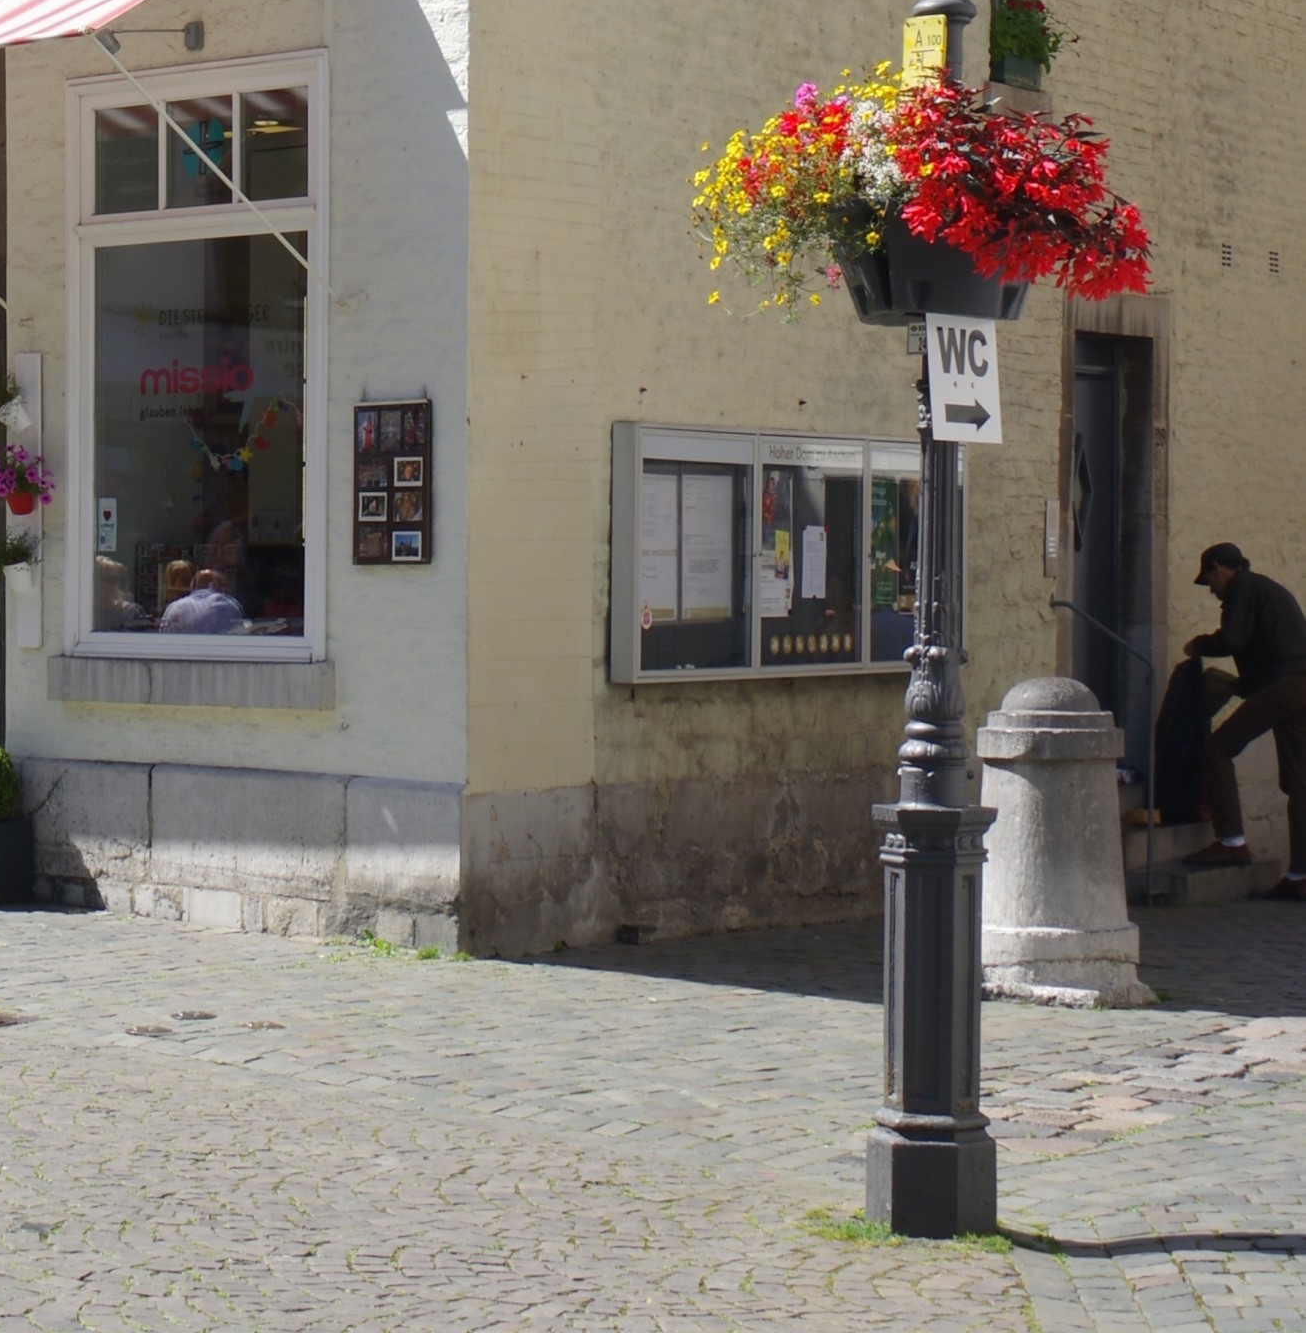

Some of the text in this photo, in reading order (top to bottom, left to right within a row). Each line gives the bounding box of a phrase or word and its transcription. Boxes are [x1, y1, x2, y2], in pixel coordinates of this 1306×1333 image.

[915, 29, 942, 47] A 100
[159, 308, 181, 327] DIE
[936, 326, 989, 378] WC
[140, 356, 255, 395] missio
